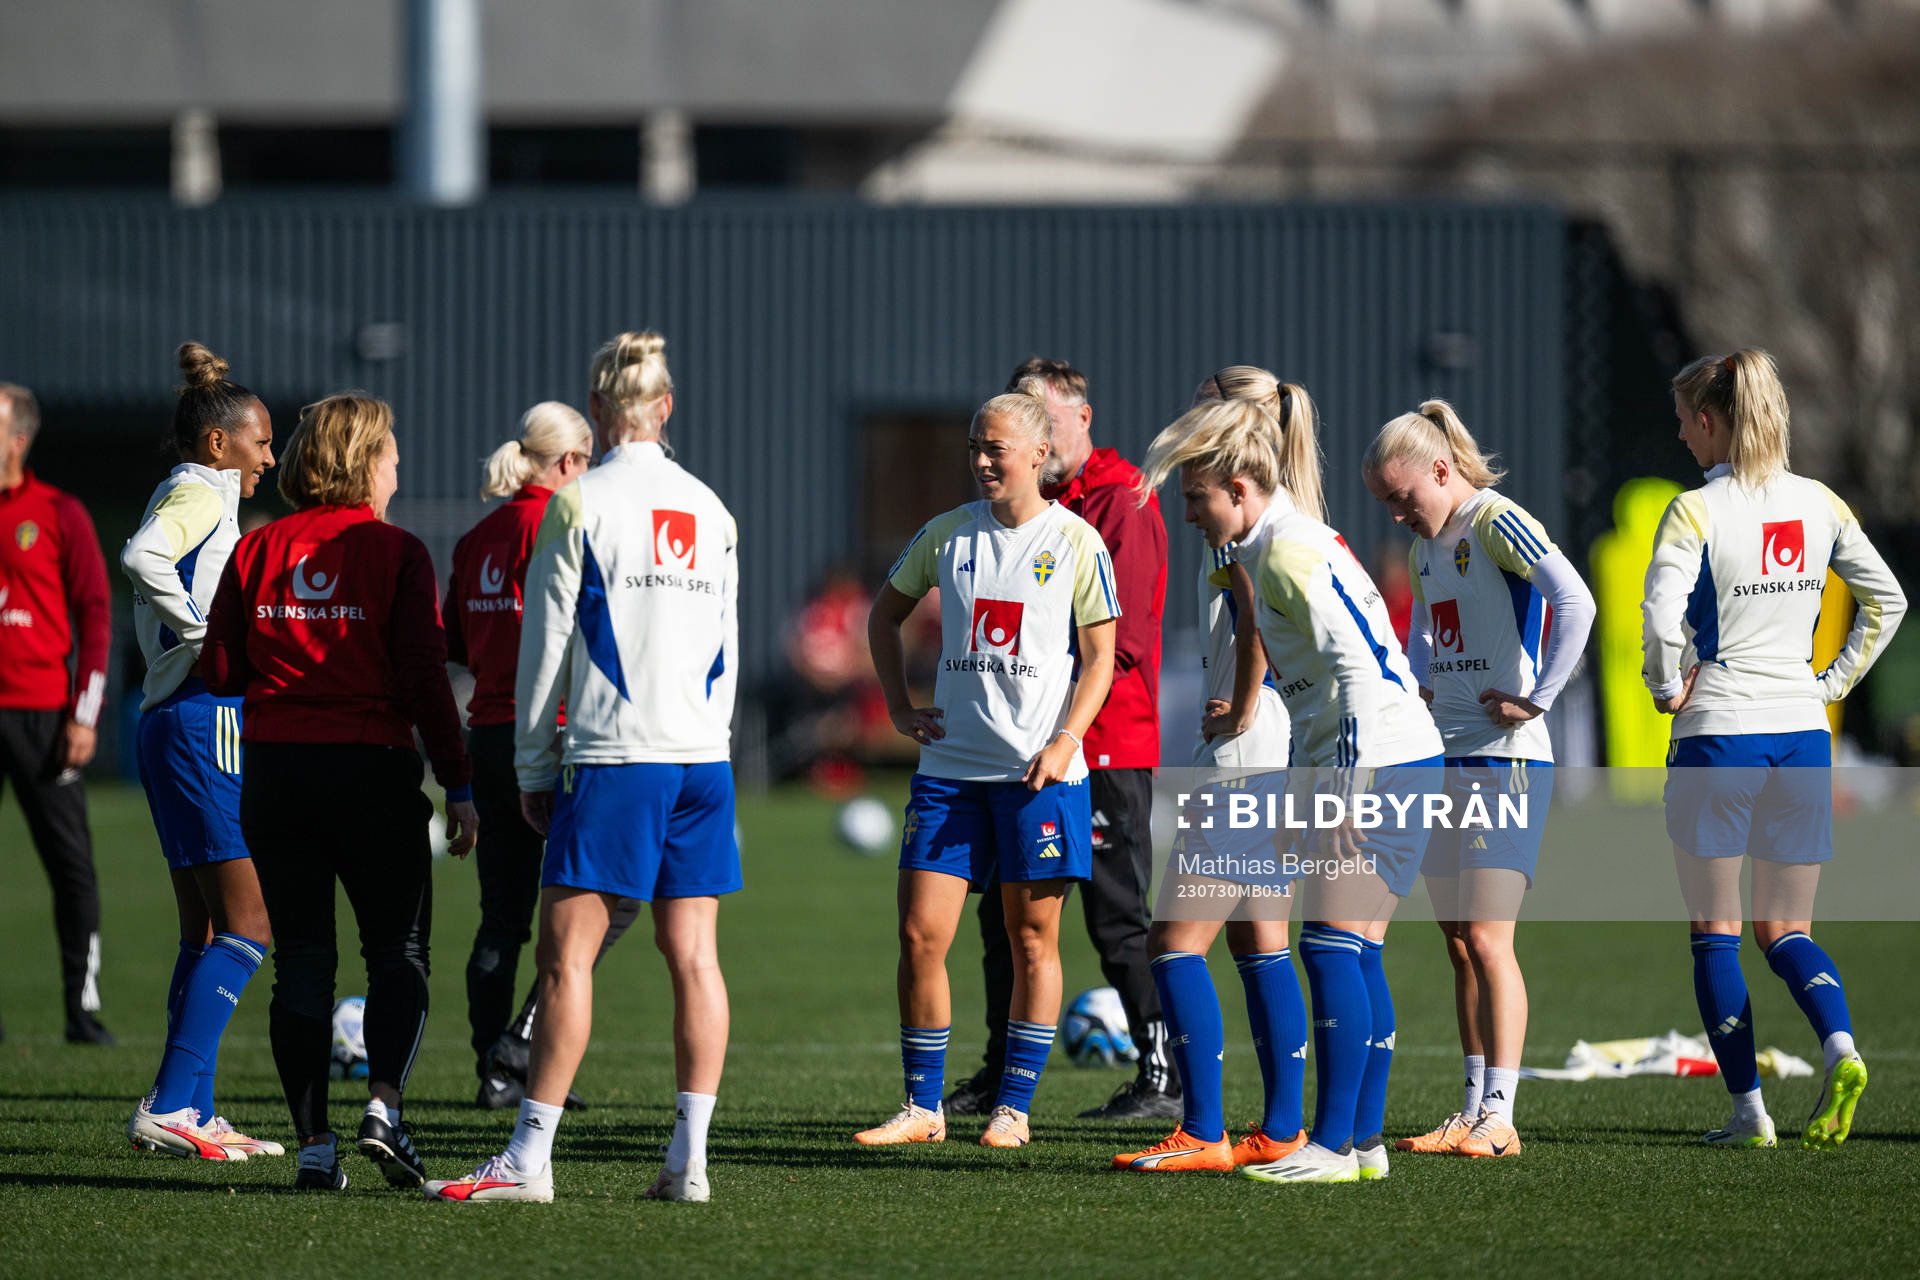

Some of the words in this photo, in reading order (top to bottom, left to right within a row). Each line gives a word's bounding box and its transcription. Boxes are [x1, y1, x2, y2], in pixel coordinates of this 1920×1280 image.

[1733, 581, 1794, 597] SVENSKA
[1797, 579, 1822, 592] SPEL
[257, 605, 327, 620] SVENSKA
[331, 605, 366, 620] SPEL
[945, 660, 1006, 674] SVENSKA
[1010, 663, 1039, 678] SPEL
[1456, 659, 1490, 672] SPEL
[1282, 678, 1314, 698] SPEL
